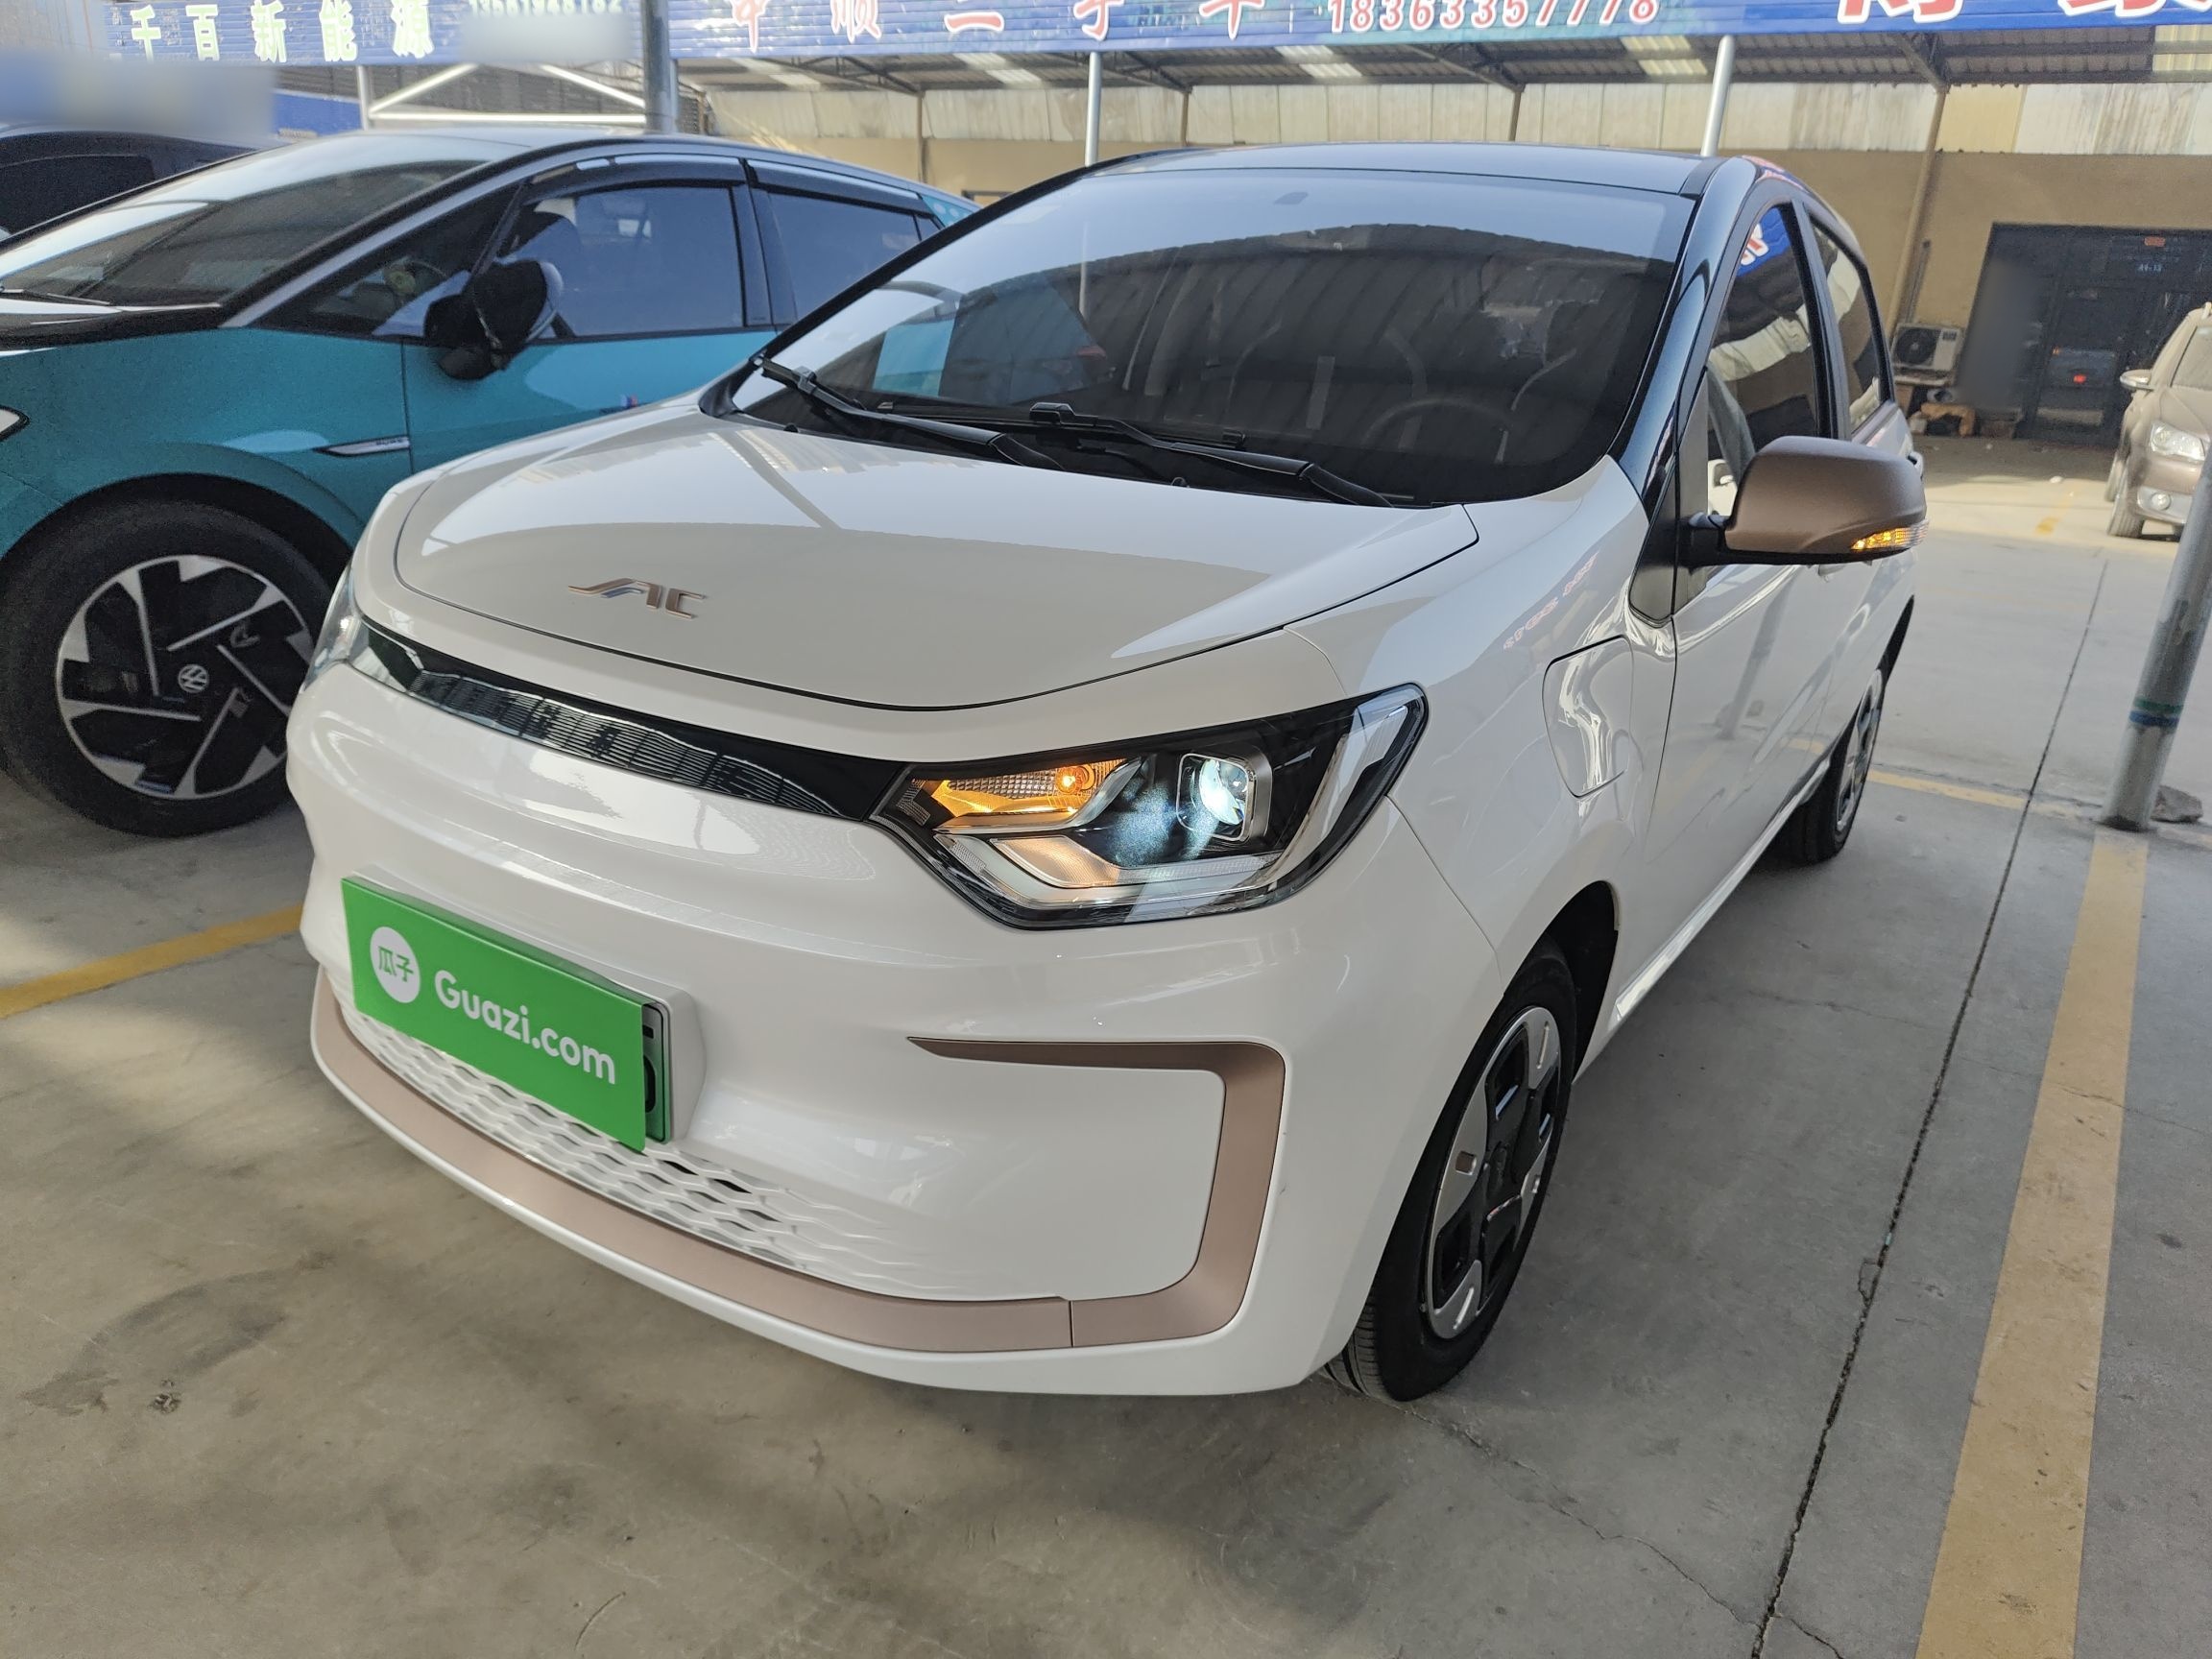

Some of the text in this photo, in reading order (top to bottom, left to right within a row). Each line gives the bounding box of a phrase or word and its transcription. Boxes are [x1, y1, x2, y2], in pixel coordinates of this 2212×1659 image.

[130, 0, 434, 61] 千百新能源
[378, 946, 414, 982] 瓜子
[434, 970, 615, 1085] Guazi.com
